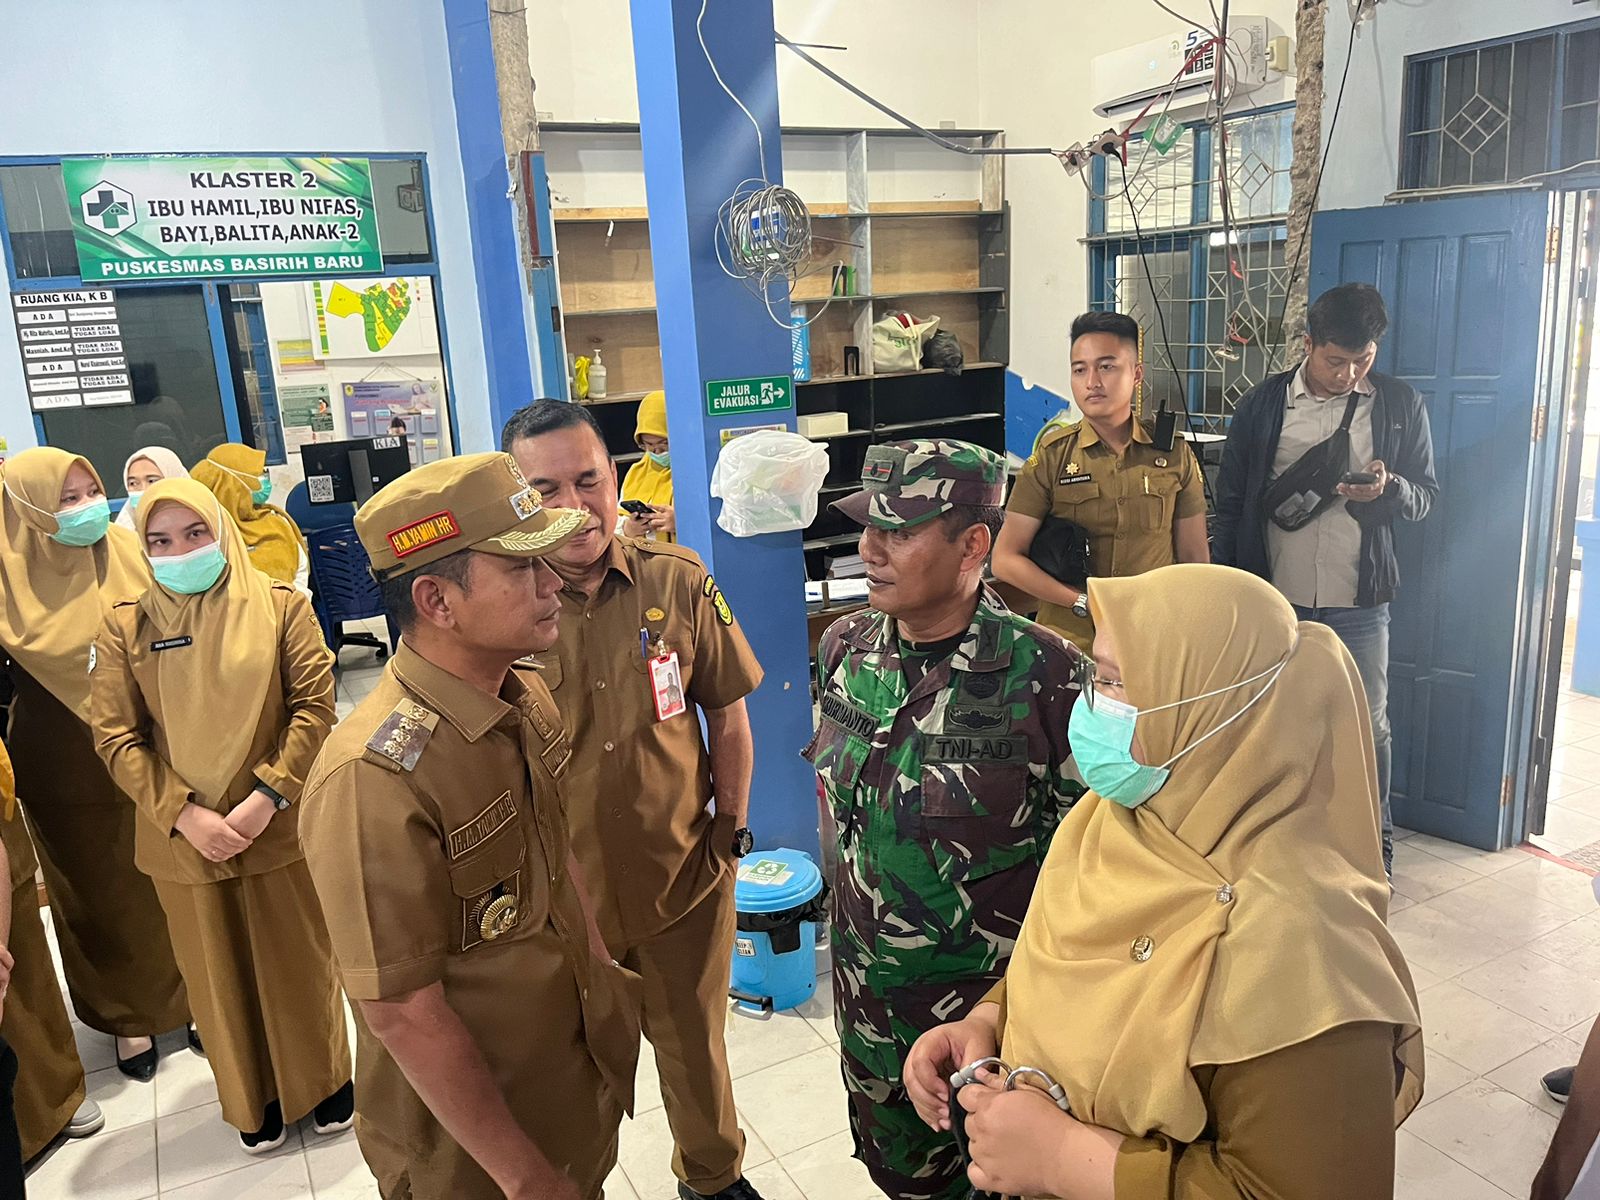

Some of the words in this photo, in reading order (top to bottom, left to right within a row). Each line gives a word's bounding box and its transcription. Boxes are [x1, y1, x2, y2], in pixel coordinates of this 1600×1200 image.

[190, 172, 296, 188] KLASTER
[302, 172, 317, 188] 2
[147, 200, 185, 217] IBU
[300, 198, 362, 219] NIFAS,
[160, 223, 359, 245] BAYI,BALITA,ANAK-2
[101, 258, 225, 276] PUSKESMAS
[230, 256, 309, 271] BASIRIH
[314, 255, 364, 269] BARU
[20, 294, 60, 304] RUANG
[63, 292, 86, 303] KIA,
[720, 384, 750, 397] JALUR
[713, 395, 759, 409] EVAKUASI
[375, 437, 399, 449] KIA
[435, 516, 454, 535] HR
[935, 739, 1013, 760] TNI-AD
